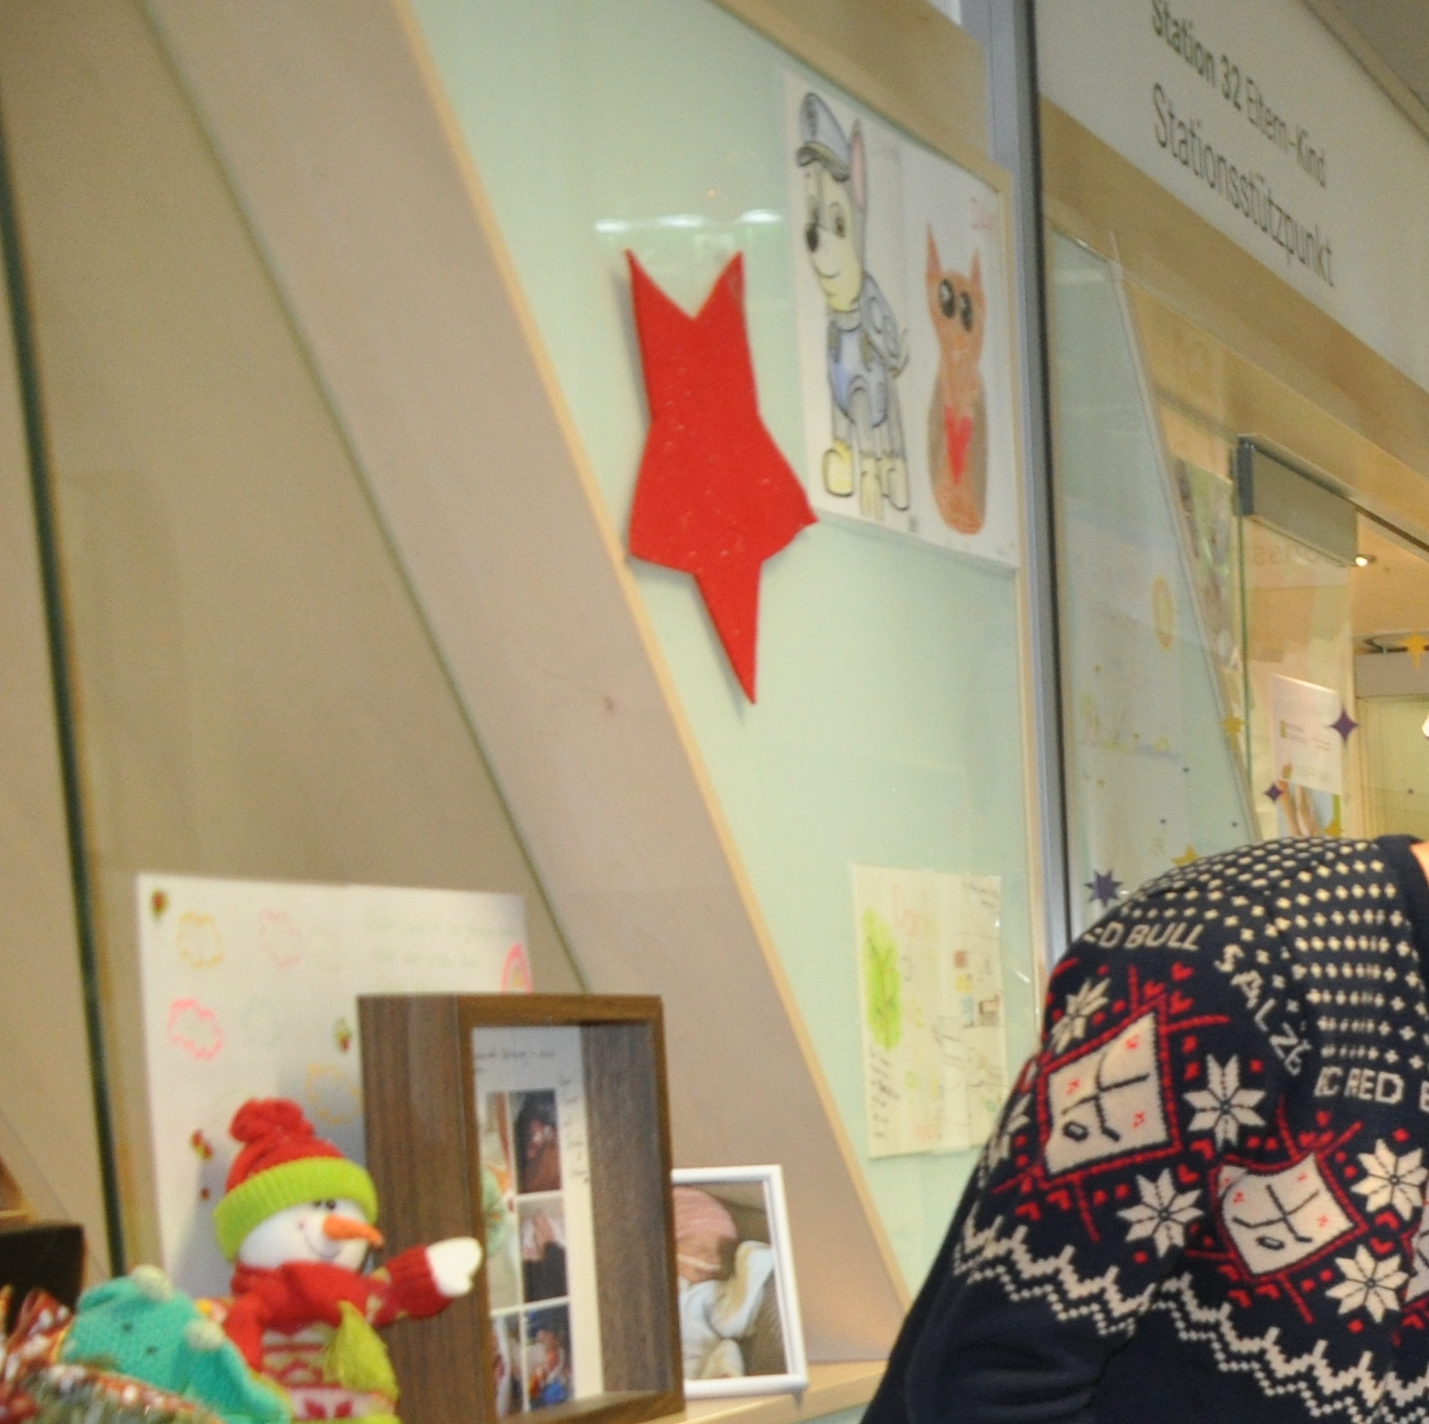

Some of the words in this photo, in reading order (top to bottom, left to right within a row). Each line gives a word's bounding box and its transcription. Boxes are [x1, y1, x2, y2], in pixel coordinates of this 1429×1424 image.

[1220, 53, 1242, 112] 32
[1152, 82, 1334, 288] Stationsstützpunkt
[1124, 921, 1204, 950] BULL
